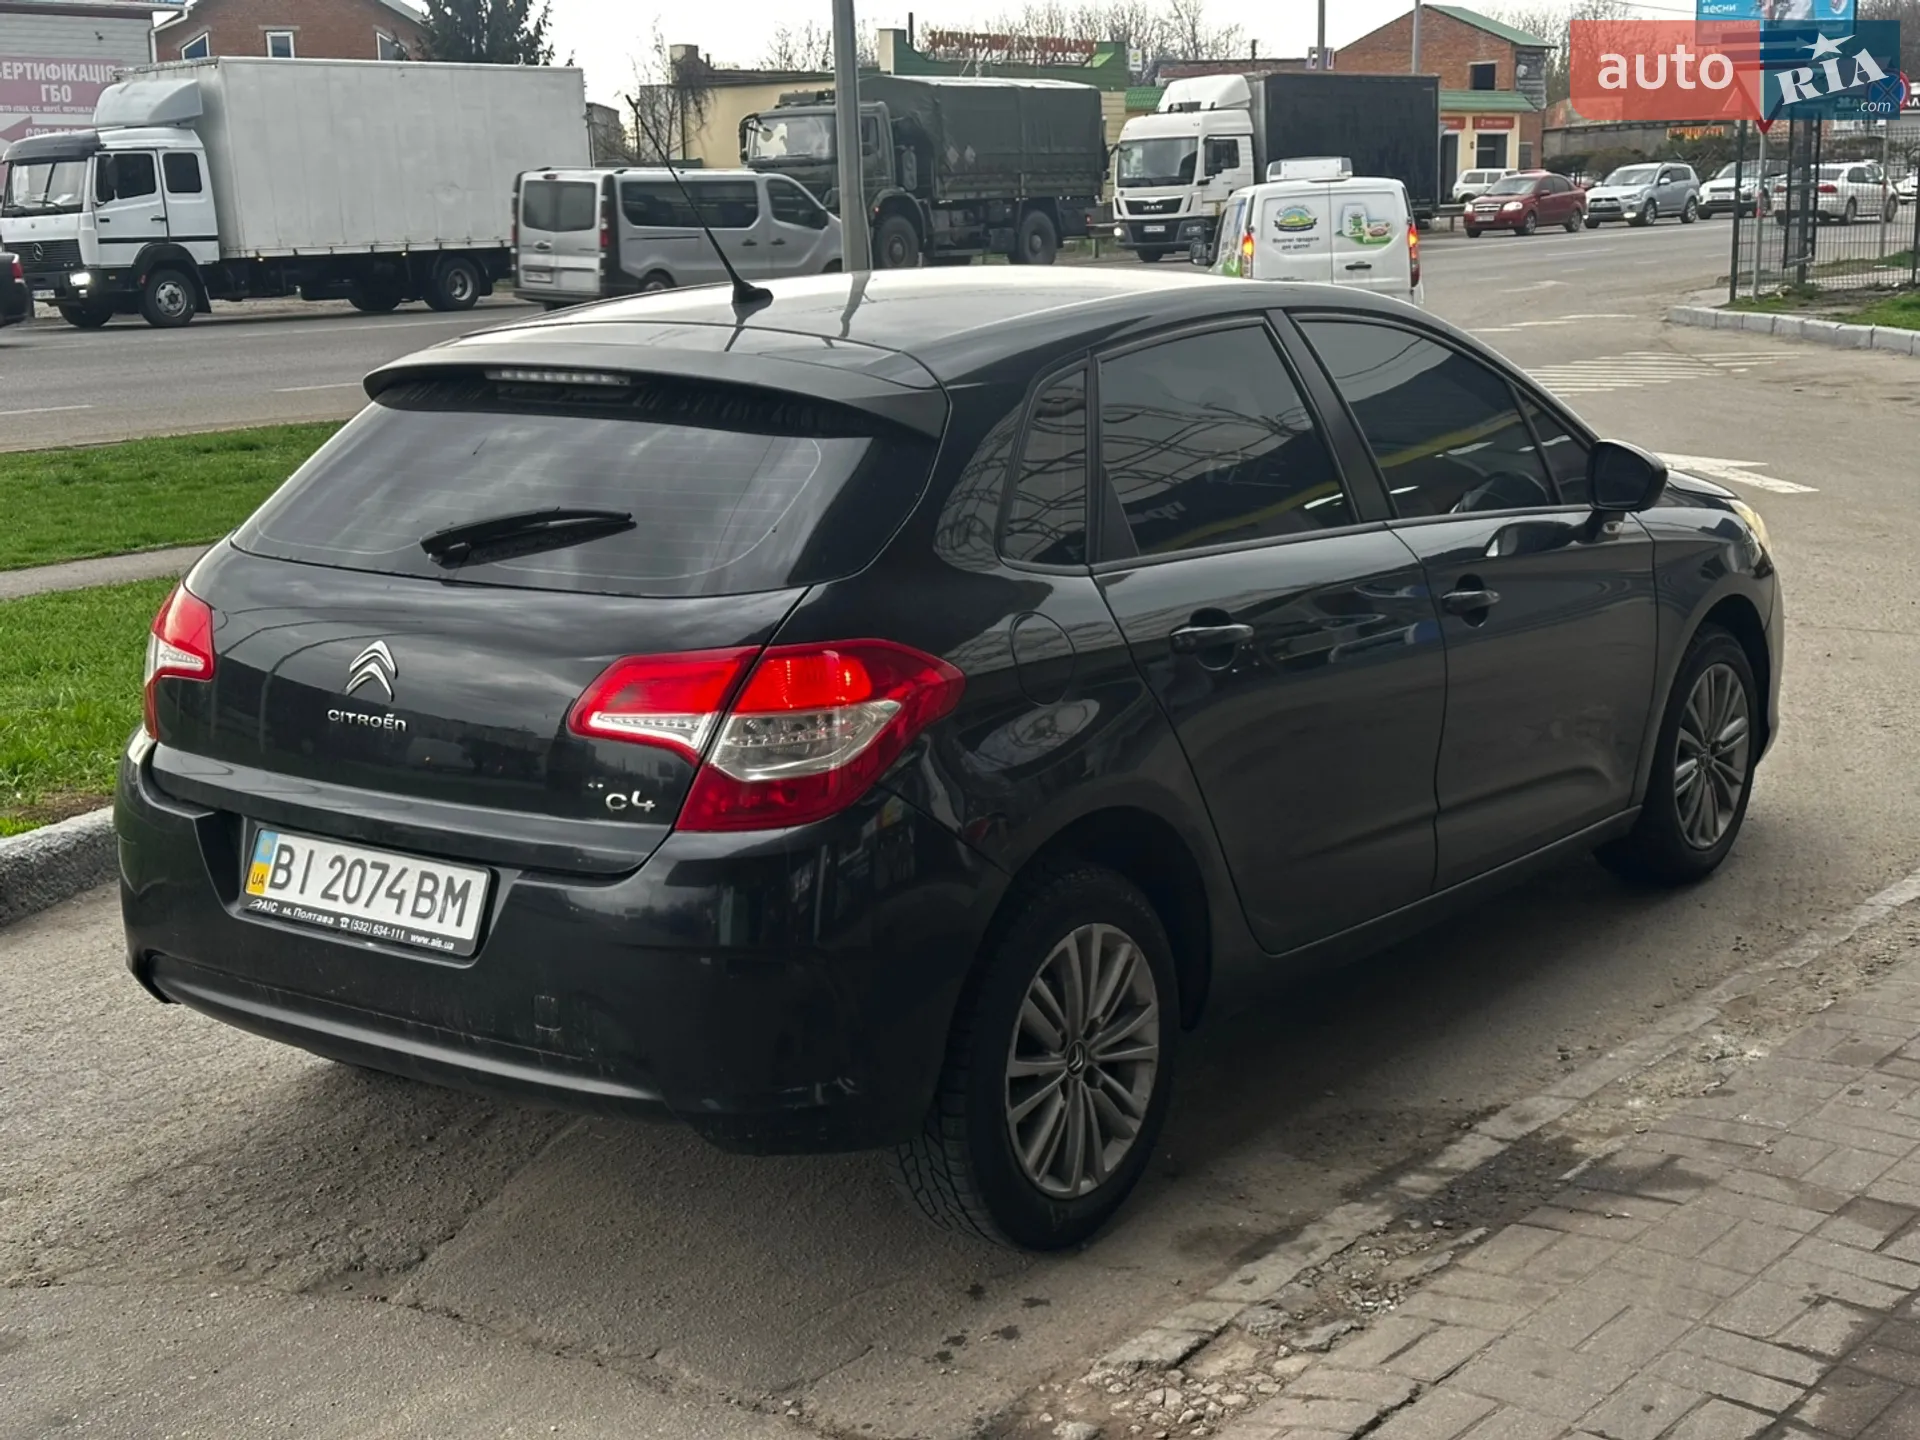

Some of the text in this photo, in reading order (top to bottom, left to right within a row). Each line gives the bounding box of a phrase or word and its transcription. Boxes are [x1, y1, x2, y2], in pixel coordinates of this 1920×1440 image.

[0, 62, 116, 84] ЕРТИФІКАЦІЯ
[41, 84, 72, 103] ГБО
[605, 790, 656, 812] C4
[251, 873, 265, 886] UA
[269, 843, 315, 895] BI
[293, 907, 335, 925] Полтава
[350, 919, 372, 933] (532)
[373, 924, 405, 940] 634-111
[410, 934, 455, 951] www.ais.ua
